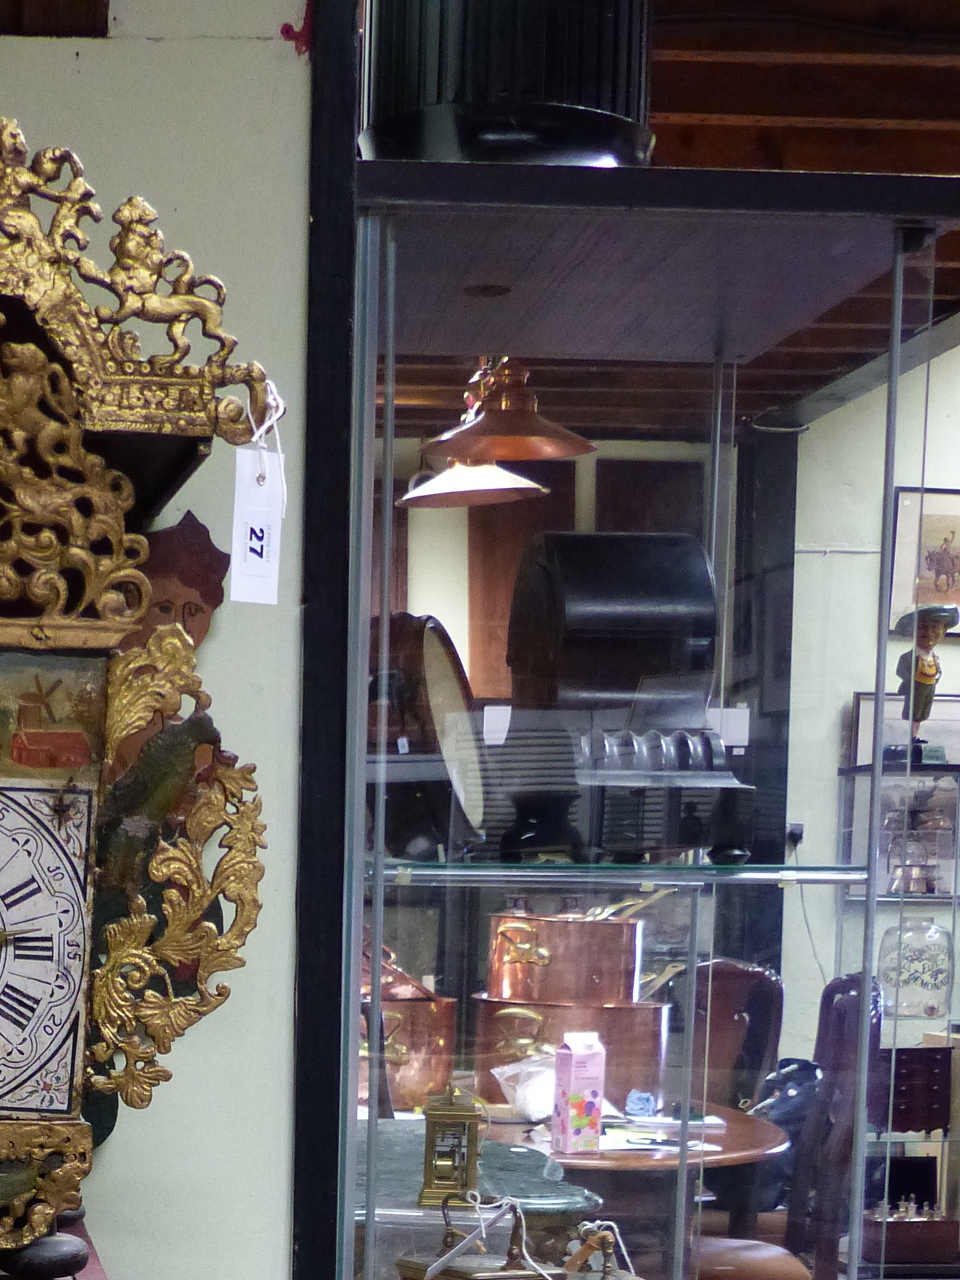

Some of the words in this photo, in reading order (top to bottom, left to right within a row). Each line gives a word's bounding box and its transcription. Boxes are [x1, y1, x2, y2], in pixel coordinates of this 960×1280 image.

[249, 527, 264, 559] 27
[46, 865, 65, 882] 10
[0, 876, 42, 912] II
[14, 934, 54, 961] III
[66, 941, 82, 962] 15
[42, 1015, 63, 1037] 20
